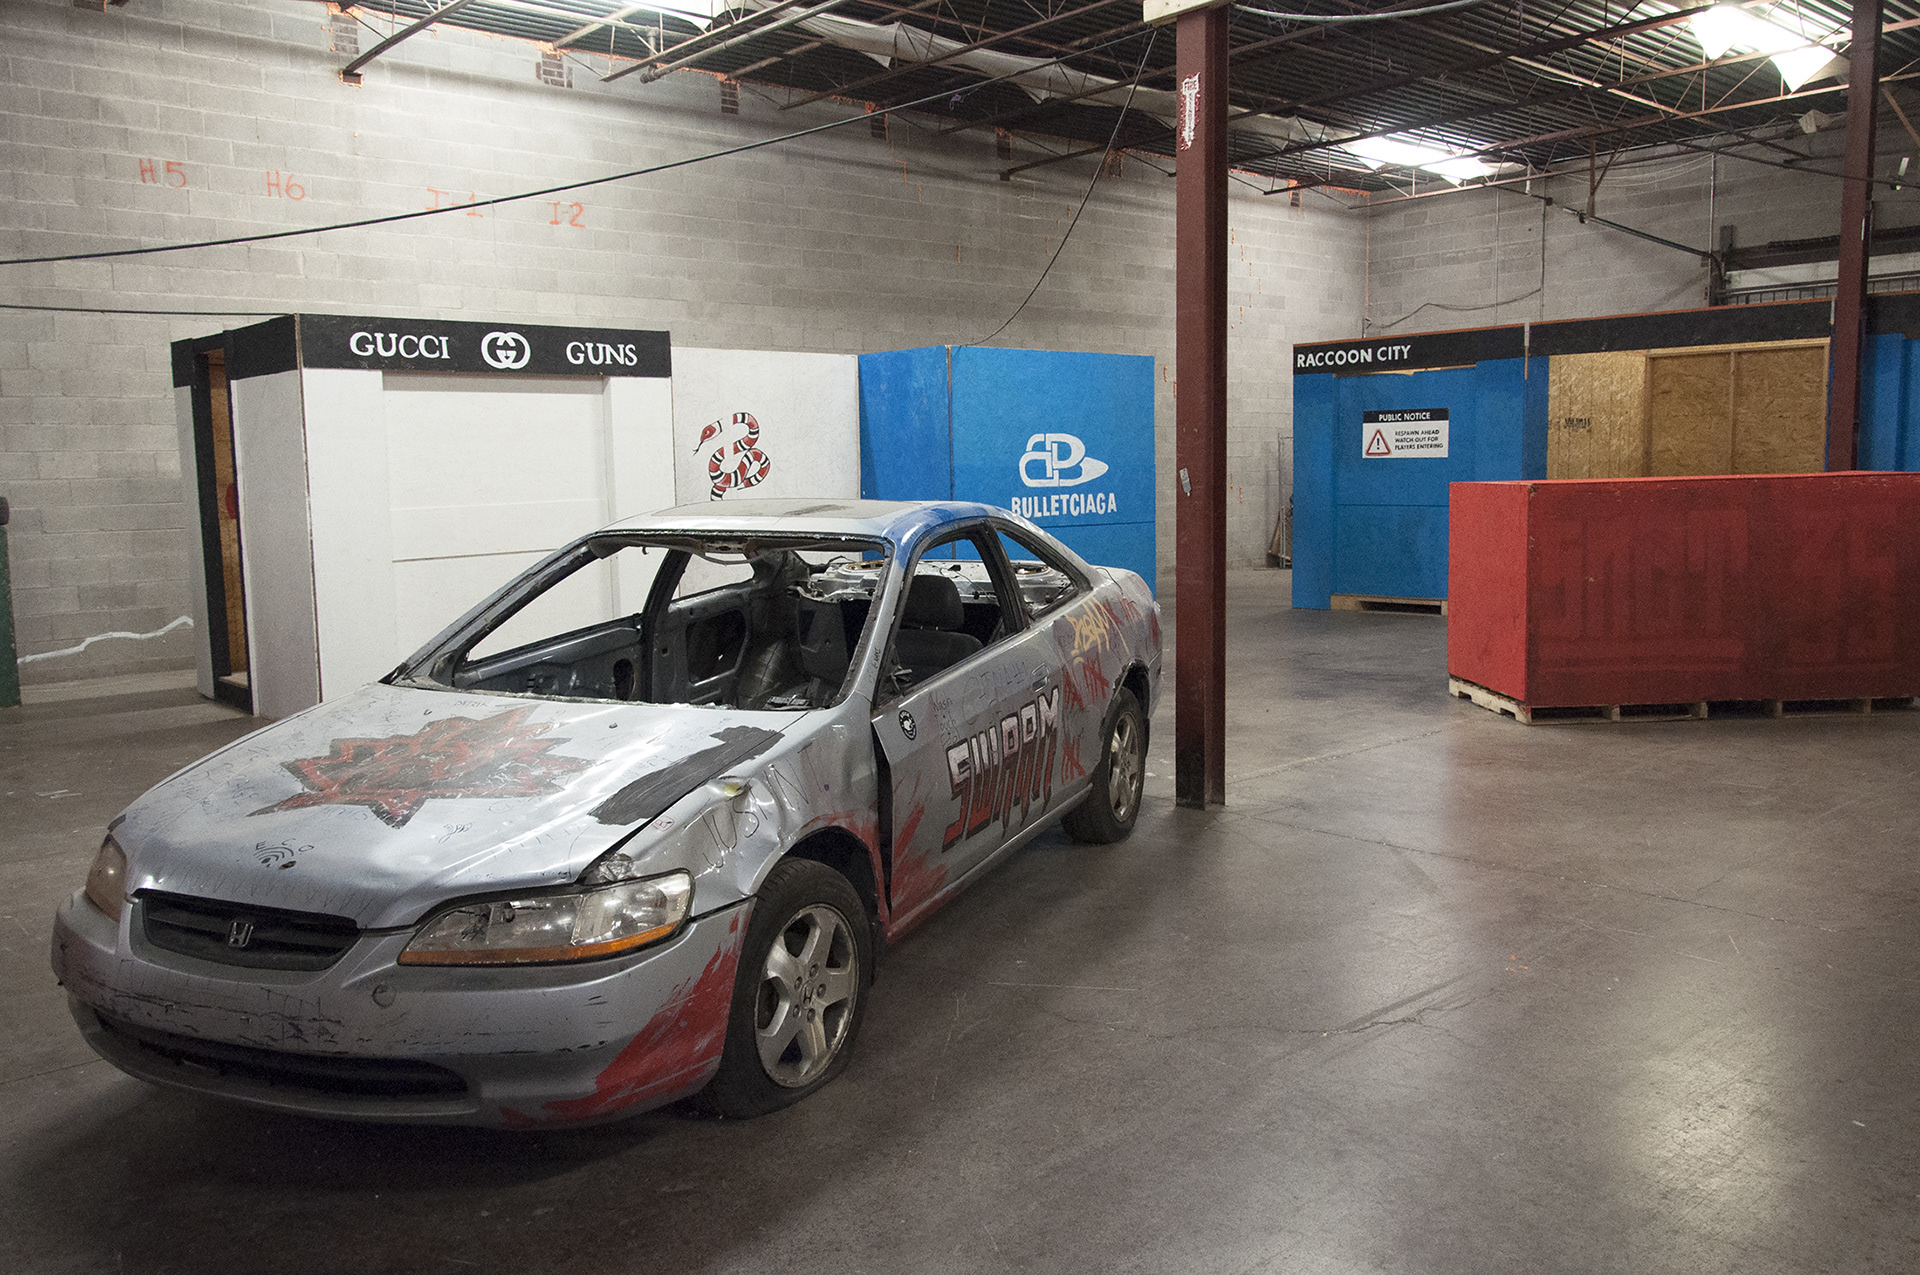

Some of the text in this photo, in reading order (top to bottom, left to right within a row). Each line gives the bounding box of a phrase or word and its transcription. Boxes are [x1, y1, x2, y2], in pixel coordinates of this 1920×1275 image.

[266, 169, 306, 201] H6
[547, 201, 586, 228] I-2
[349, 331, 451, 359] GUCCI
[565, 341, 638, 366] GUNS
[1296, 344, 1411, 369] RACCOON CITY
[1378, 411, 1431, 422] PUBLIC NOTICE
[1011, 492, 1117, 519] BULLETCIAGA
